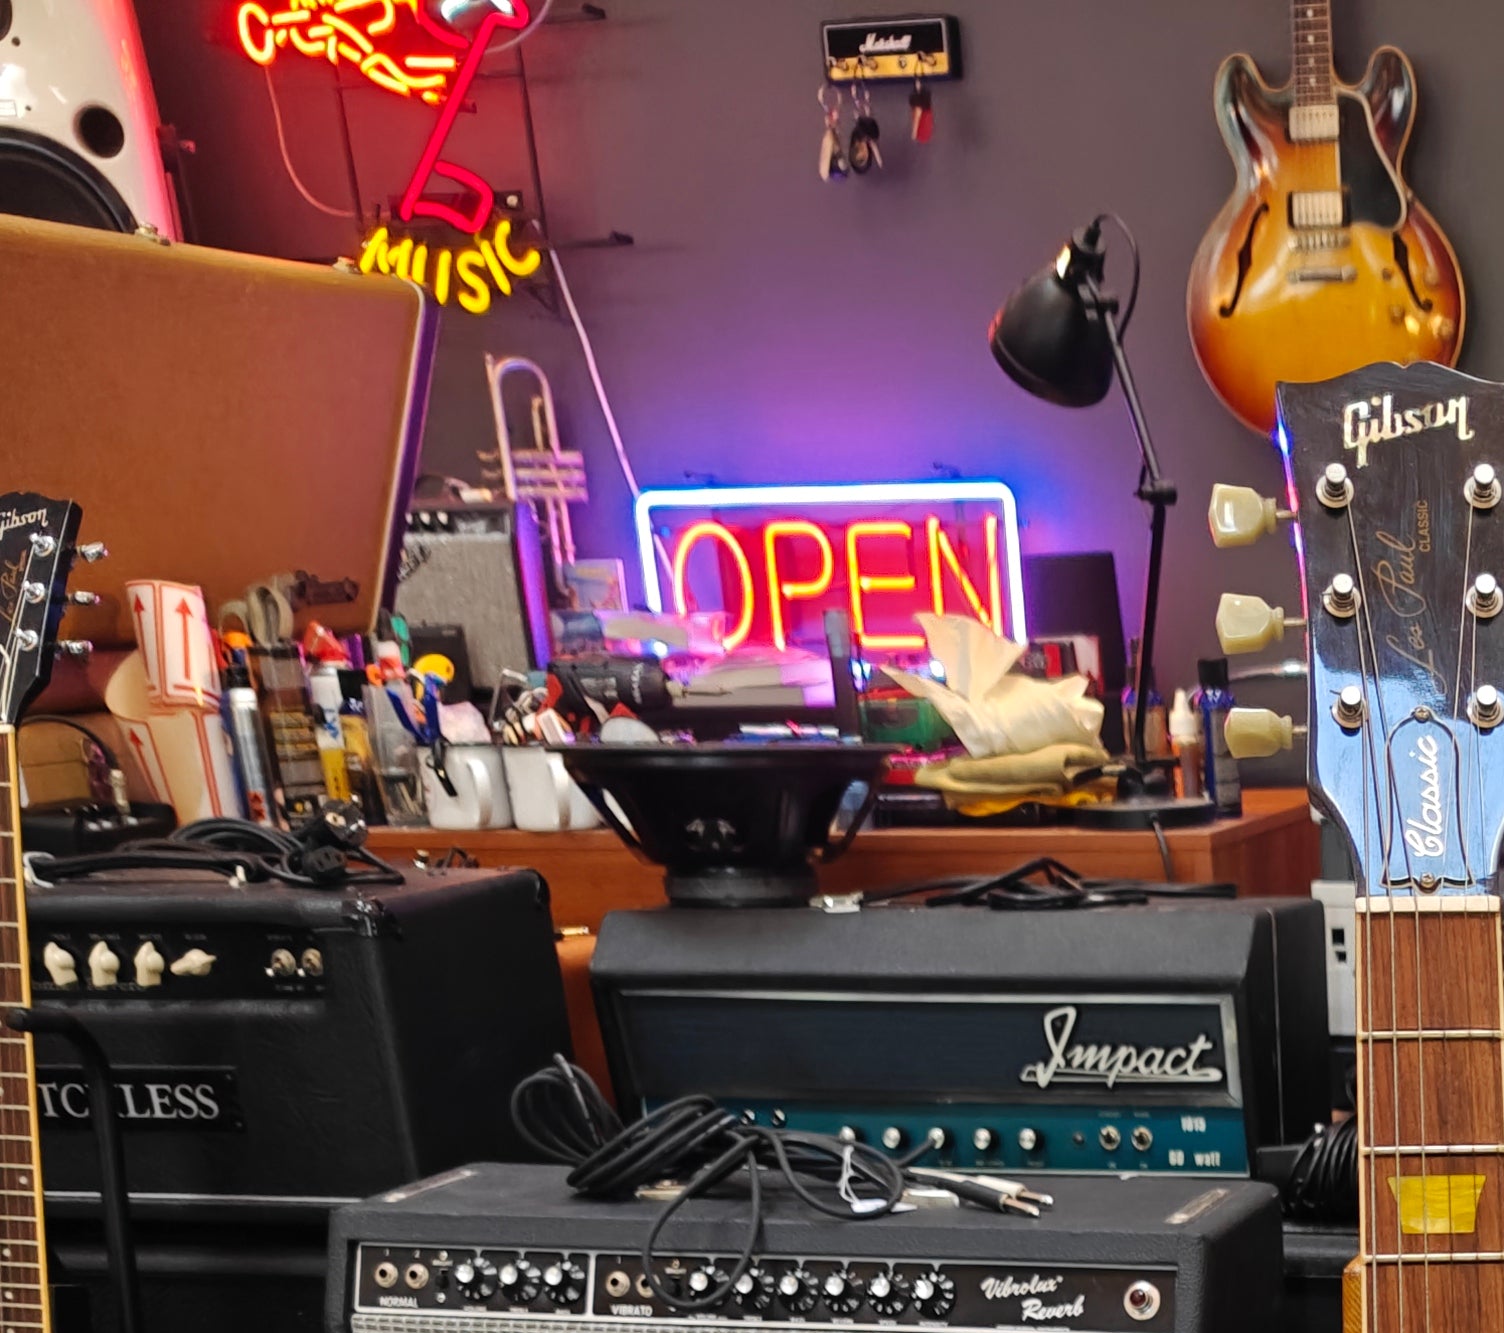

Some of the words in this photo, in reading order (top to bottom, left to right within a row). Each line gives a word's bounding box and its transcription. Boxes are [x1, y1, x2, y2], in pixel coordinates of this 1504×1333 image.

[359, 219, 541, 313] MUSIC
[1343, 393, 1475, 468] Gibson
[1416, 499, 1431, 552] CLASSIC
[673, 511, 1003, 652] OPEN
[1371, 530, 1427, 617] Paul
[1386, 622, 1448, 696] Les
[1404, 733, 1446, 858] Classic
[1020, 1005, 1222, 1089] Impact
[38, 1082, 220, 1119] TCLESS
[1194, 1150, 1221, 1167] watt
[379, 1296, 419, 1309] NORMAL
[611, 1304, 653, 1317] VIBRATO
[981, 1274, 1058, 1300] Vibrolux
[1021, 1294, 1085, 1322] Reverb
